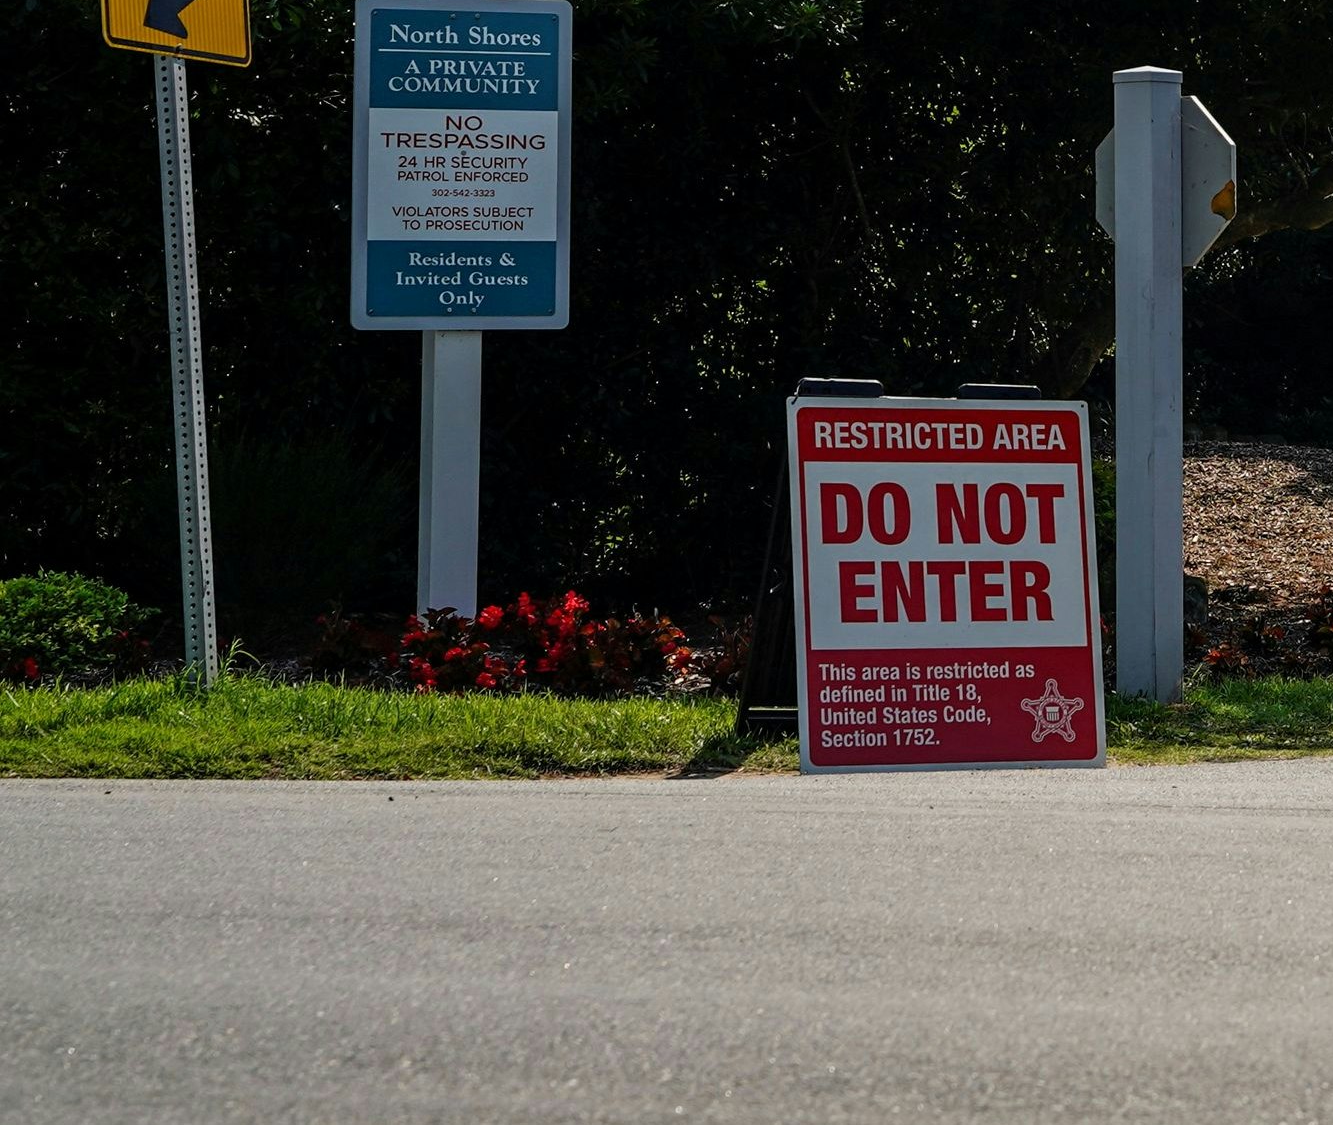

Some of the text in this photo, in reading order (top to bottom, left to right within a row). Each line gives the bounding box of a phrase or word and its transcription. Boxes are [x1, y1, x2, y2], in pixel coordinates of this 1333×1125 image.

[389, 24, 541, 47] North Shores
[404, 59, 526, 77] A PRIVATE
[388, 77, 540, 95] COMMUNITY
[445, 115, 483, 131] NO
[380, 132, 546, 150] TRESPASSING
[397, 155, 529, 169] 24 HR SECURITY
[397, 171, 529, 183] PATROL ENFORCED
[431, 188, 496, 198] 302-542-3323
[391, 206, 535, 218] VIOLATORS SUBJECT
[402, 219, 524, 231] TO PROSECUTION
[408, 252, 516, 267] Residents &
[396, 271, 529, 286] Invited Guests
[439, 291, 485, 308] Only
[814, 421, 1066, 451] RESTRICTED AREA
[819, 481, 1065, 546] DO NOT
[838, 560, 1055, 623] ENTER
[818, 662, 1035, 682] This area is restricted as
[819, 684, 982, 704] defined in Title 18,
[820, 705, 992, 726] United States Code,
[821, 728, 941, 748] Section 1752.
